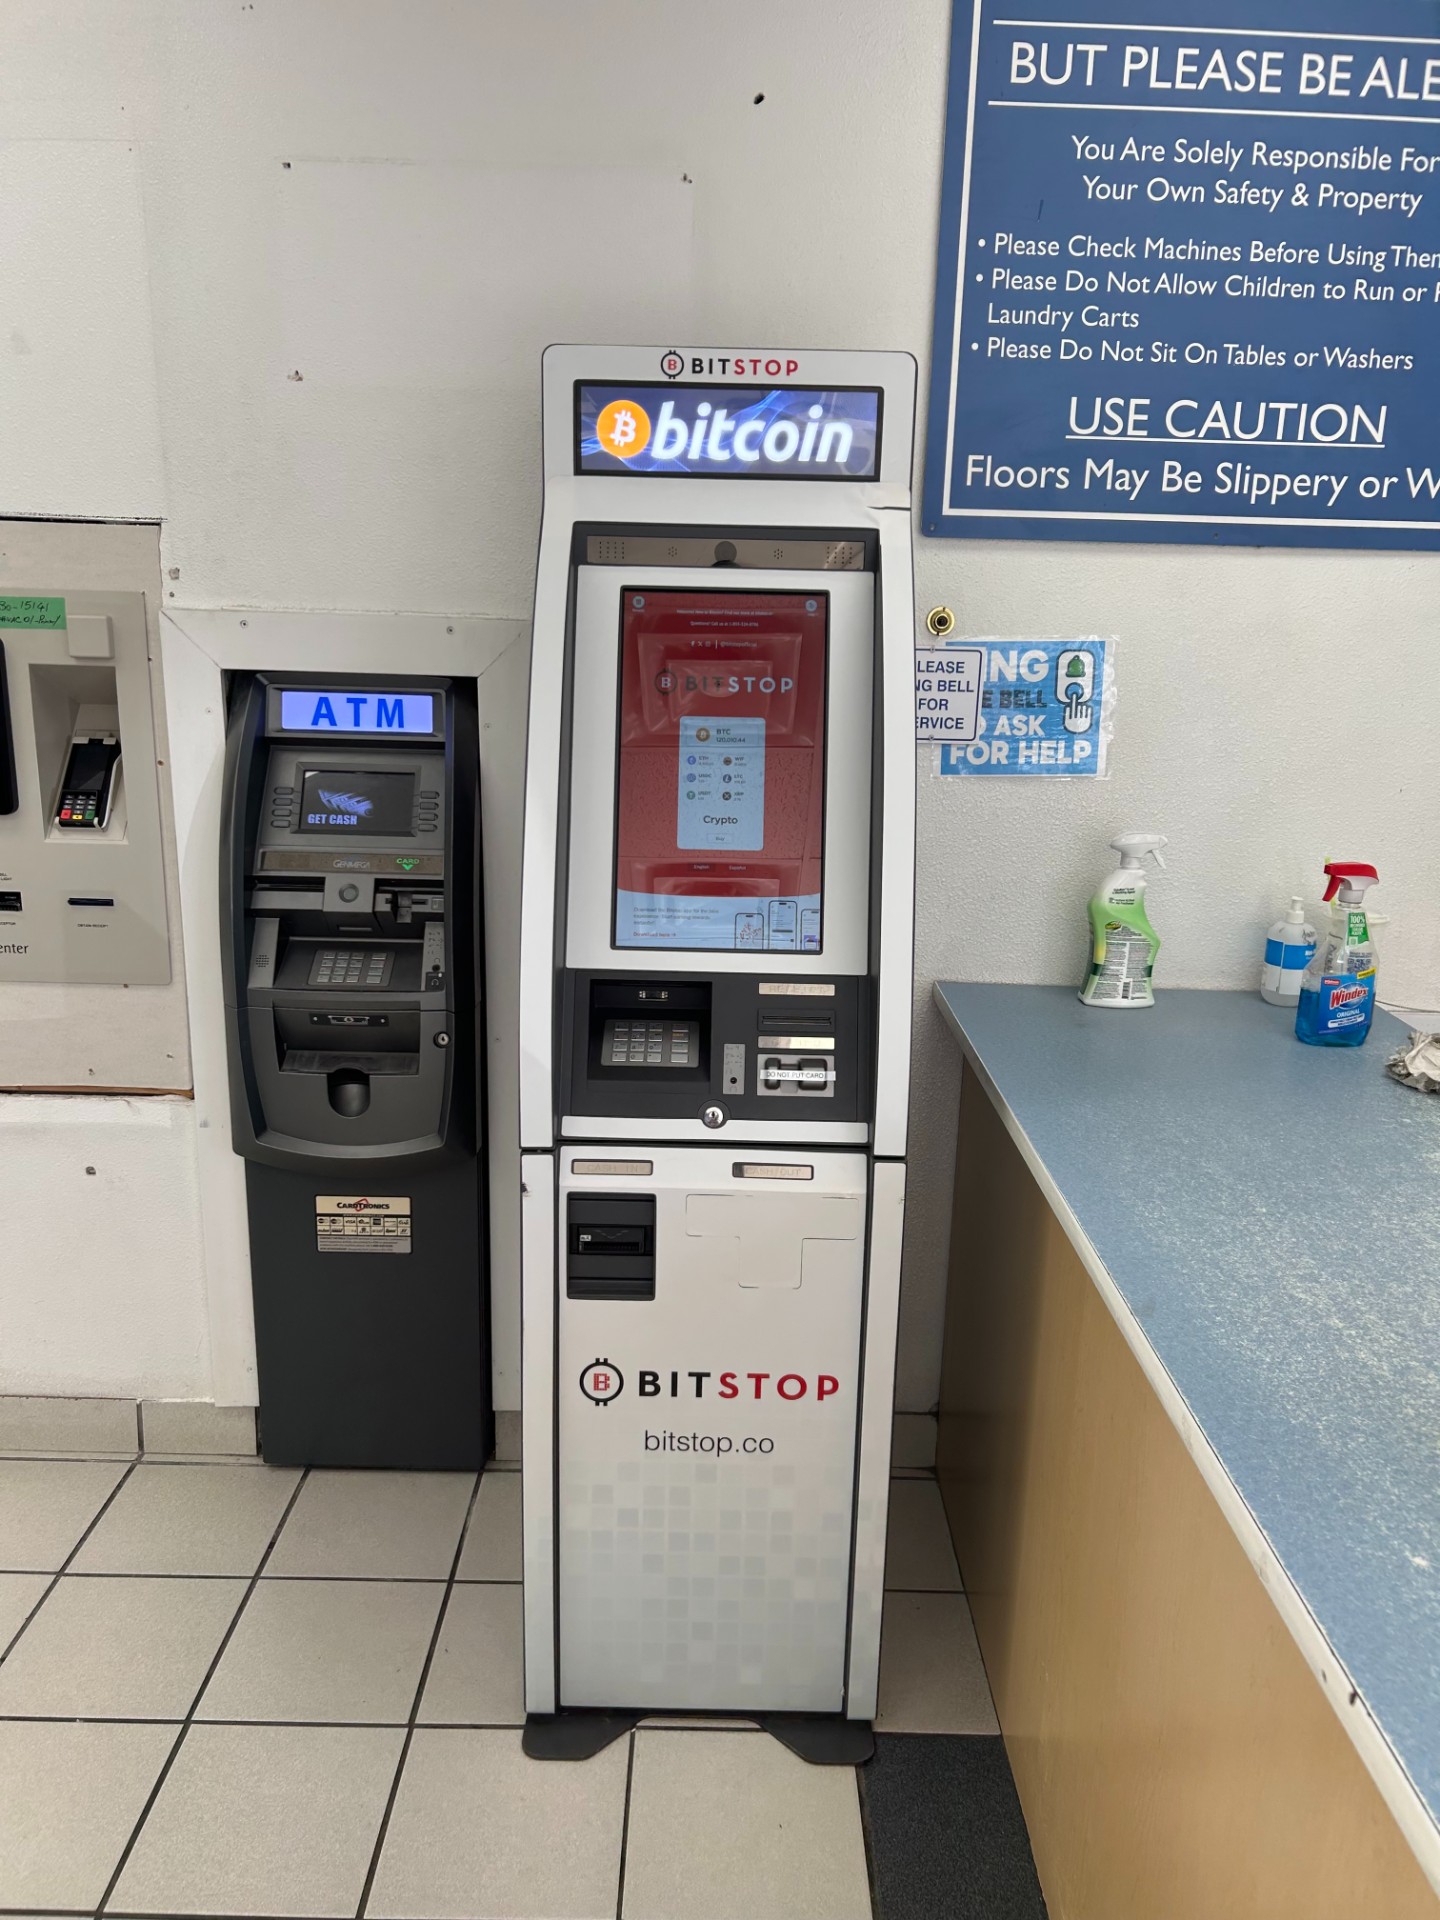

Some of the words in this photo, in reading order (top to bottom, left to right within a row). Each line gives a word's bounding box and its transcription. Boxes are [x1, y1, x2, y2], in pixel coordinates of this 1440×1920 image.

[1010, 41, 1108, 87] BUT
[1122, 45, 1285, 94] PLEASE
[1298, 52, 1354, 97] BE
[1359, 56, 1440, 101] ALE
[1072, 135, 1115, 160] You
[1119, 137, 1166, 162] Are
[1173, 139, 1244, 173] Solely
[1251, 142, 1392, 175] Responsible
[1400, 147, 1440, 173] For
[1083, 175, 1139, 200] Your
[1146, 177, 1205, 203] Own
[1213, 180, 1285, 213] Safety
[1290, 183, 1310, 207] &
[1317, 183, 1424, 218] Property
[994, 233, 1060, 256] Please
[1068, 235, 1137, 258] Check
[1145, 237, 1242, 262] Machines
[1250, 241, 1320, 265] Before
[1327, 243, 1388, 273] Using
[991, 268, 1057, 291] Please
[1065, 270, 1099, 292] Do
[1106, 271, 1151, 294] Not
[1153, 273, 1218, 296] Allow
[1224, 275, 1315, 299] Children
[1323, 282, 1346, 300] to
[1353, 279, 1395, 301] Run
[1402, 287, 1428, 302] or
[987, 303, 1074, 333] Laundry
[1081, 305, 1140, 328] Carts
[987, 337, 1052, 360] Please
[1060, 339, 1093, 361] Do
[1100, 340, 1144, 362] Not
[1150, 342, 1178, 363] Sit
[1184, 343, 1218, 365] On
[1223, 344, 1287, 367] Tables
[1293, 352, 1320, 367] or
[1324, 346, 1414, 370] Washers
[691, 358, 799, 377] BITSTOP
[1069, 396, 1151, 437] USE
[1165, 399, 1388, 443] CAUTION
[651, 401, 854, 463] bitcoin
[966, 455, 1070, 490] Floors
[1083, 458, 1150, 501] May
[1161, 460, 1203, 493] Be
[1214, 461, 1349, 507] Slippery
[1359, 476, 1399, 498] or
[917, 660, 966, 674] LEASE
[685, 676, 793, 693] BITSTOP
[937, 680, 975, 693] BELL
[918, 698, 949, 711] FOR
[999, 690, 1048, 709] BELL
[311, 696, 405, 729] ATM
[993, 714, 1047, 737] ASK
[949, 741, 1009, 765] FOR
[1018, 741, 1092, 765] HELP
[308, 814, 327, 825] GET
[329, 814, 358, 825] CASH
[703, 815, 738, 826] Crypto
[1350, 915, 1365, 924] 100%
[1329, 987, 1369, 1010] Windex
[1337, 1008, 1360, 1018] ORIGINAL
[337, 1201, 390, 1210] CARDTRONICS
[638, 1370, 840, 1401] BITSTOP
[644, 1429, 775, 1457] bitstop.co
